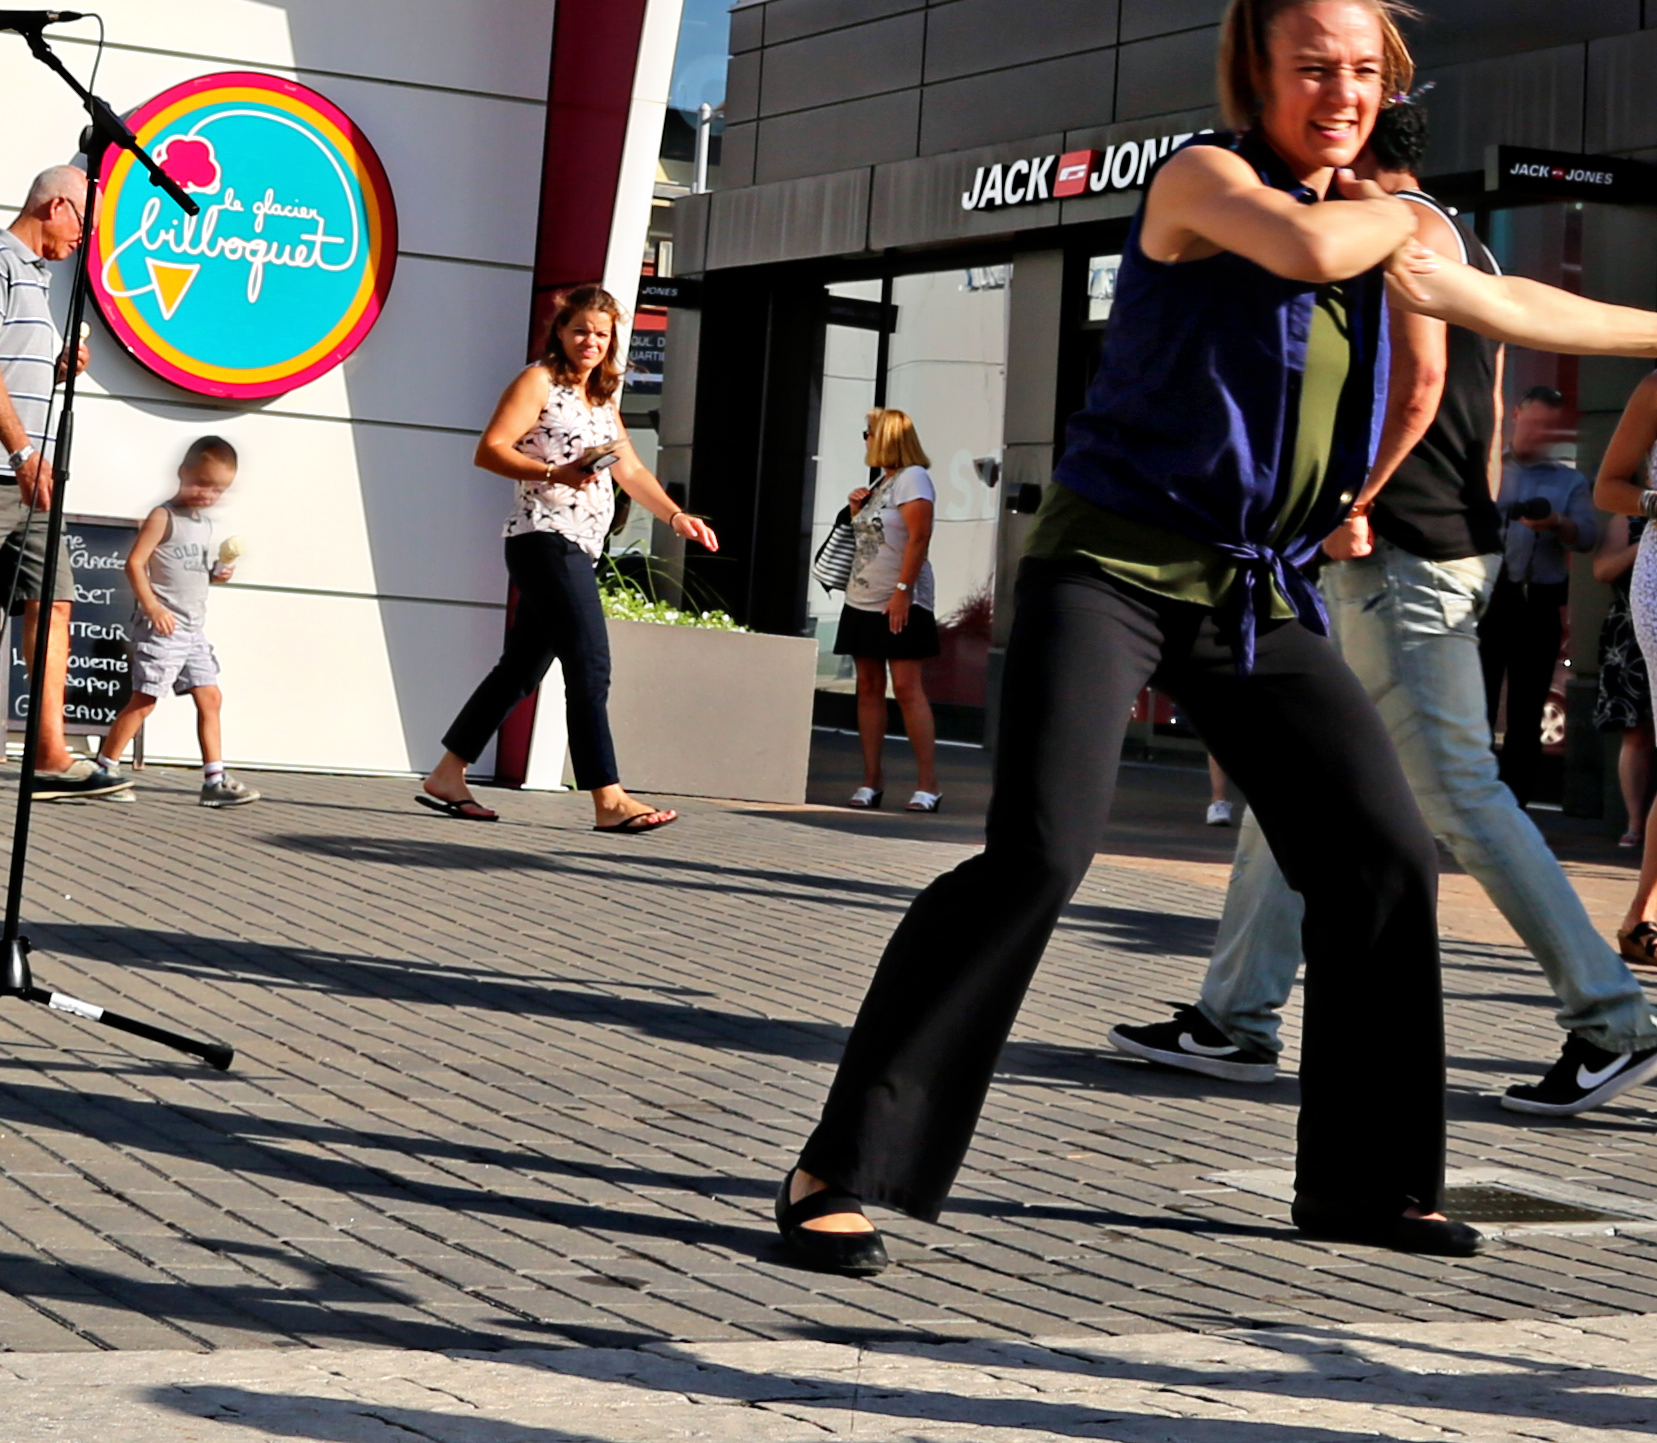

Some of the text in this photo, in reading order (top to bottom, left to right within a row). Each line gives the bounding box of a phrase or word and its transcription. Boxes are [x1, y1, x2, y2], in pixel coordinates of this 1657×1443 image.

[962, 155, 1055, 210] JACK
[1510, 163, 1613, 185] JACK JONES
[642, 286, 678, 297] JONES
